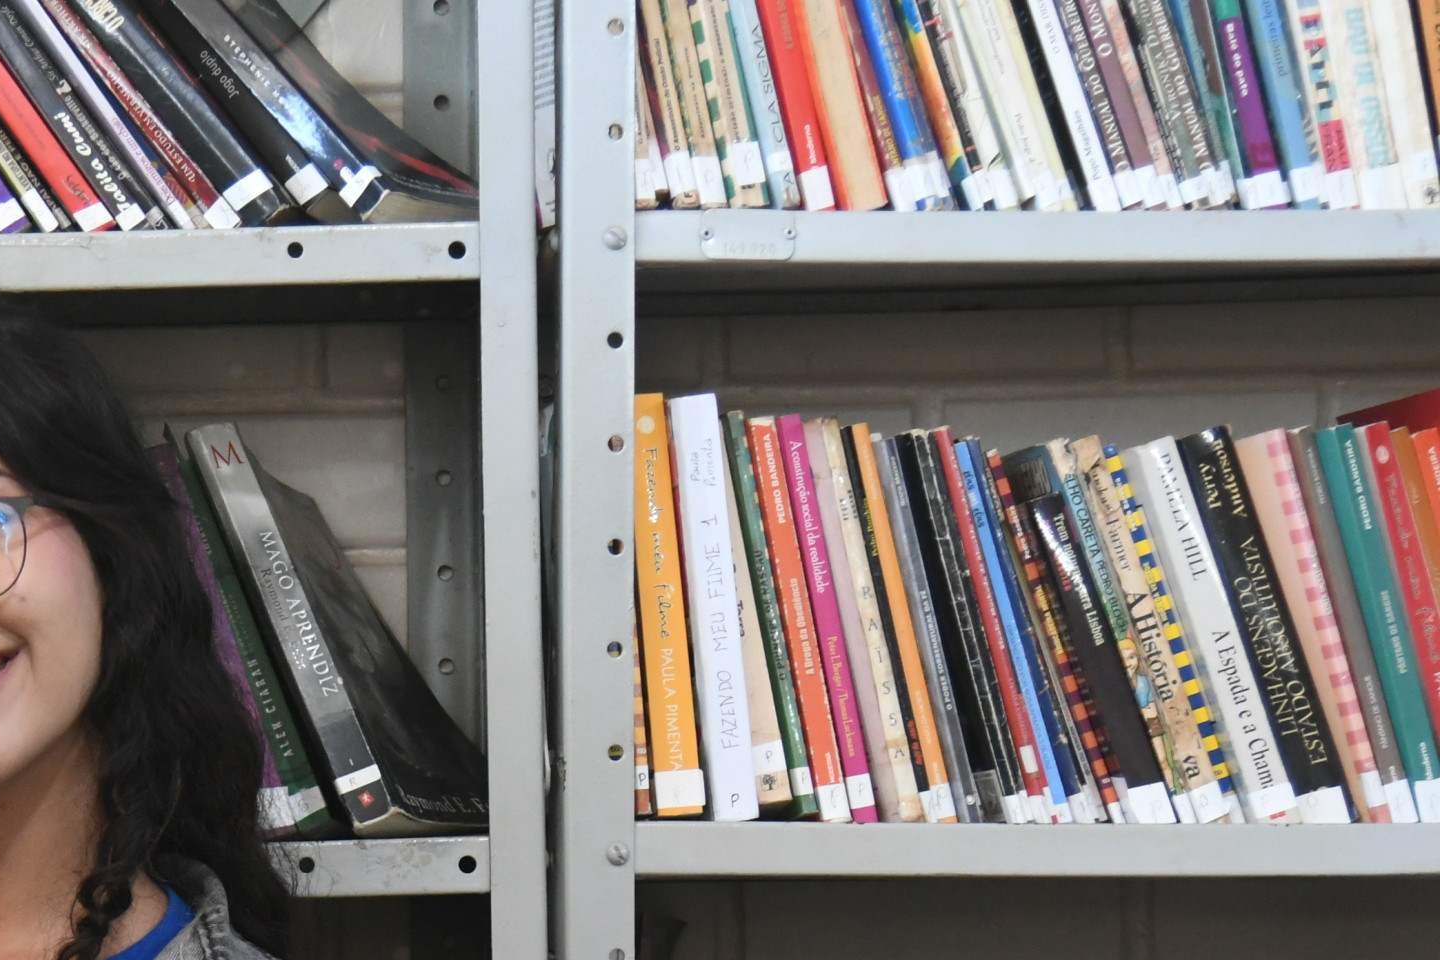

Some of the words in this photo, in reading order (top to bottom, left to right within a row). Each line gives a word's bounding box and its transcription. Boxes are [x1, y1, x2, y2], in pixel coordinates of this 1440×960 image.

[196, 47, 224, 77] duplo
[1096, 41, 1113, 58] O
[1262, 20, 1290, 77] primeiras
[216, 72, 241, 99] Jogo
[1087, 74, 1104, 95] DO
[62, 93, 99, 141] Baskerville
[1093, 97, 1125, 157] MANUAL
[1178, 99, 1209, 157] MANUAL
[152, 128, 183, 164] ESTUDO
[802, 124, 818, 164] Moderna
[211, 440, 246, 469] M
[761, 433, 779, 487] BANDEIRA
[788, 450, 812, 503] construção
[1342, 439, 1364, 493] BANDEIRA
[1197, 461, 1222, 509] Perry
[1210, 438, 1248, 521] Anderson
[772, 489, 786, 523] PEDRO
[800, 502, 817, 531] social
[1357, 494, 1373, 530] PEDRO
[806, 531, 820, 545] da
[1180, 535, 1209, 581] HILL
[807, 546, 830, 593] realidade
[1232, 574, 1257, 608] DO
[257, 528, 295, 591] MAGO
[284, 594, 340, 697] APRENDIZ
[1123, 587, 1149, 610] A
[1238, 535, 1298, 676] ABSOLUTISTA
[924, 614, 944, 674] SOBRENATURAL
[1084, 610, 1105, 646] Lisboa
[1211, 627, 1228, 642] A
[658, 647, 678, 698] PAULA
[1129, 609, 1185, 702] História
[1212, 645, 1251, 707] Espada
[1244, 612, 1297, 737] LINHAGENS
[715, 669, 740, 749] FAZENDO
[1237, 709, 1250, 720] e
[1242, 723, 1254, 734] a
[1285, 677, 1328, 765] ESTADO
[663, 702, 686, 771] PIMENTA
